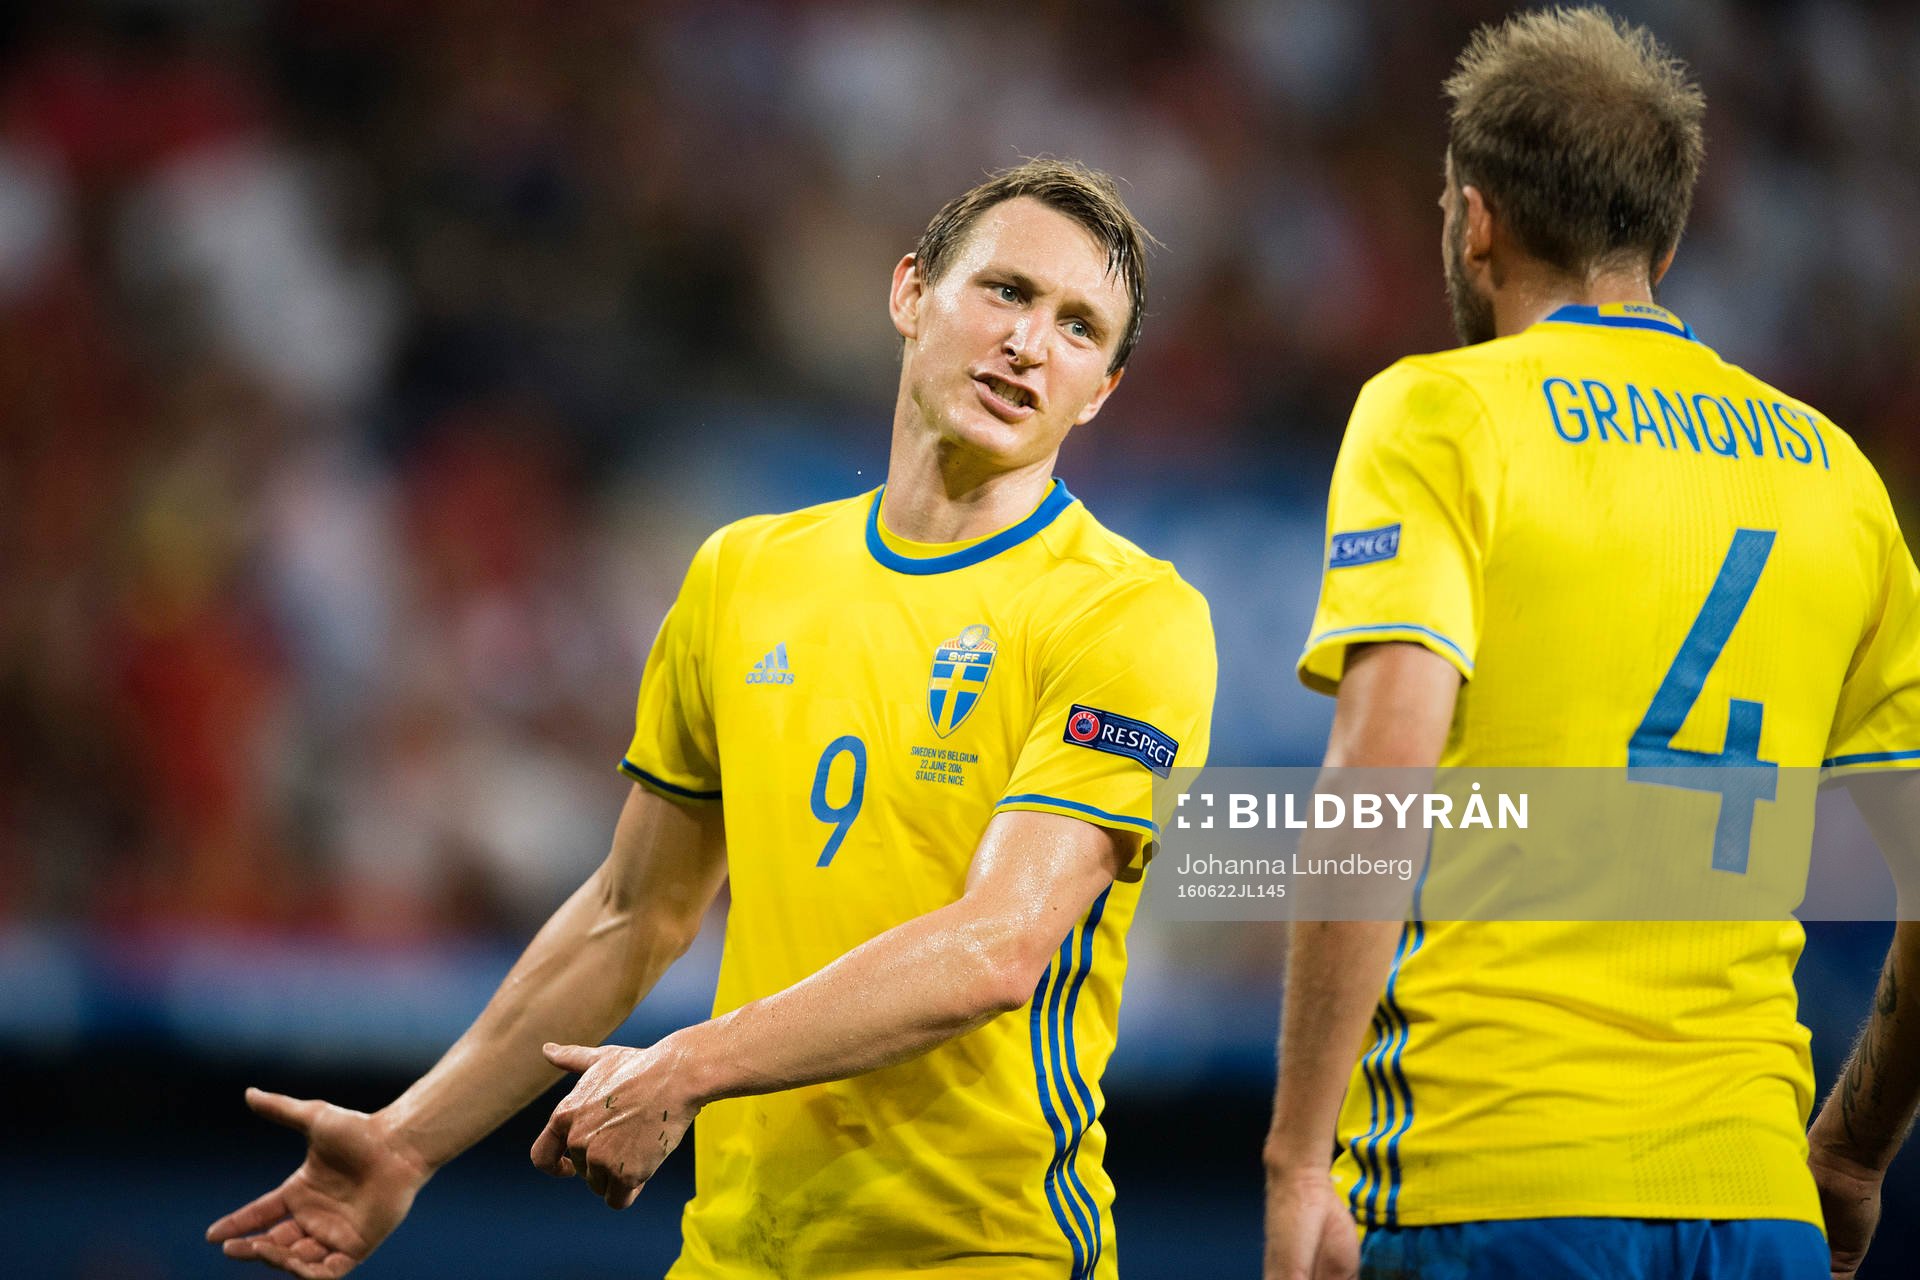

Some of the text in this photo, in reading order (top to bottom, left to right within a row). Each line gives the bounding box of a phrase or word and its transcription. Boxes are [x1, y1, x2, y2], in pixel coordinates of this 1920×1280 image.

[1542, 377, 1830, 470] GRANQVIST
[1330, 530, 1398, 560] ESPECT
[745, 670, 794, 685] adidas
[1627, 528, 1778, 874] 4
[1077, 712, 1096, 722] UEFA
[912, 746, 978, 763] SWEDEN VS BELGIUM
[1101, 724, 1175, 767] RESPECT
[916, 771, 964, 785] STADE DE NICE
[920, 760, 962, 773] 22 JUNE 2016
[810, 735, 867, 867] 9
